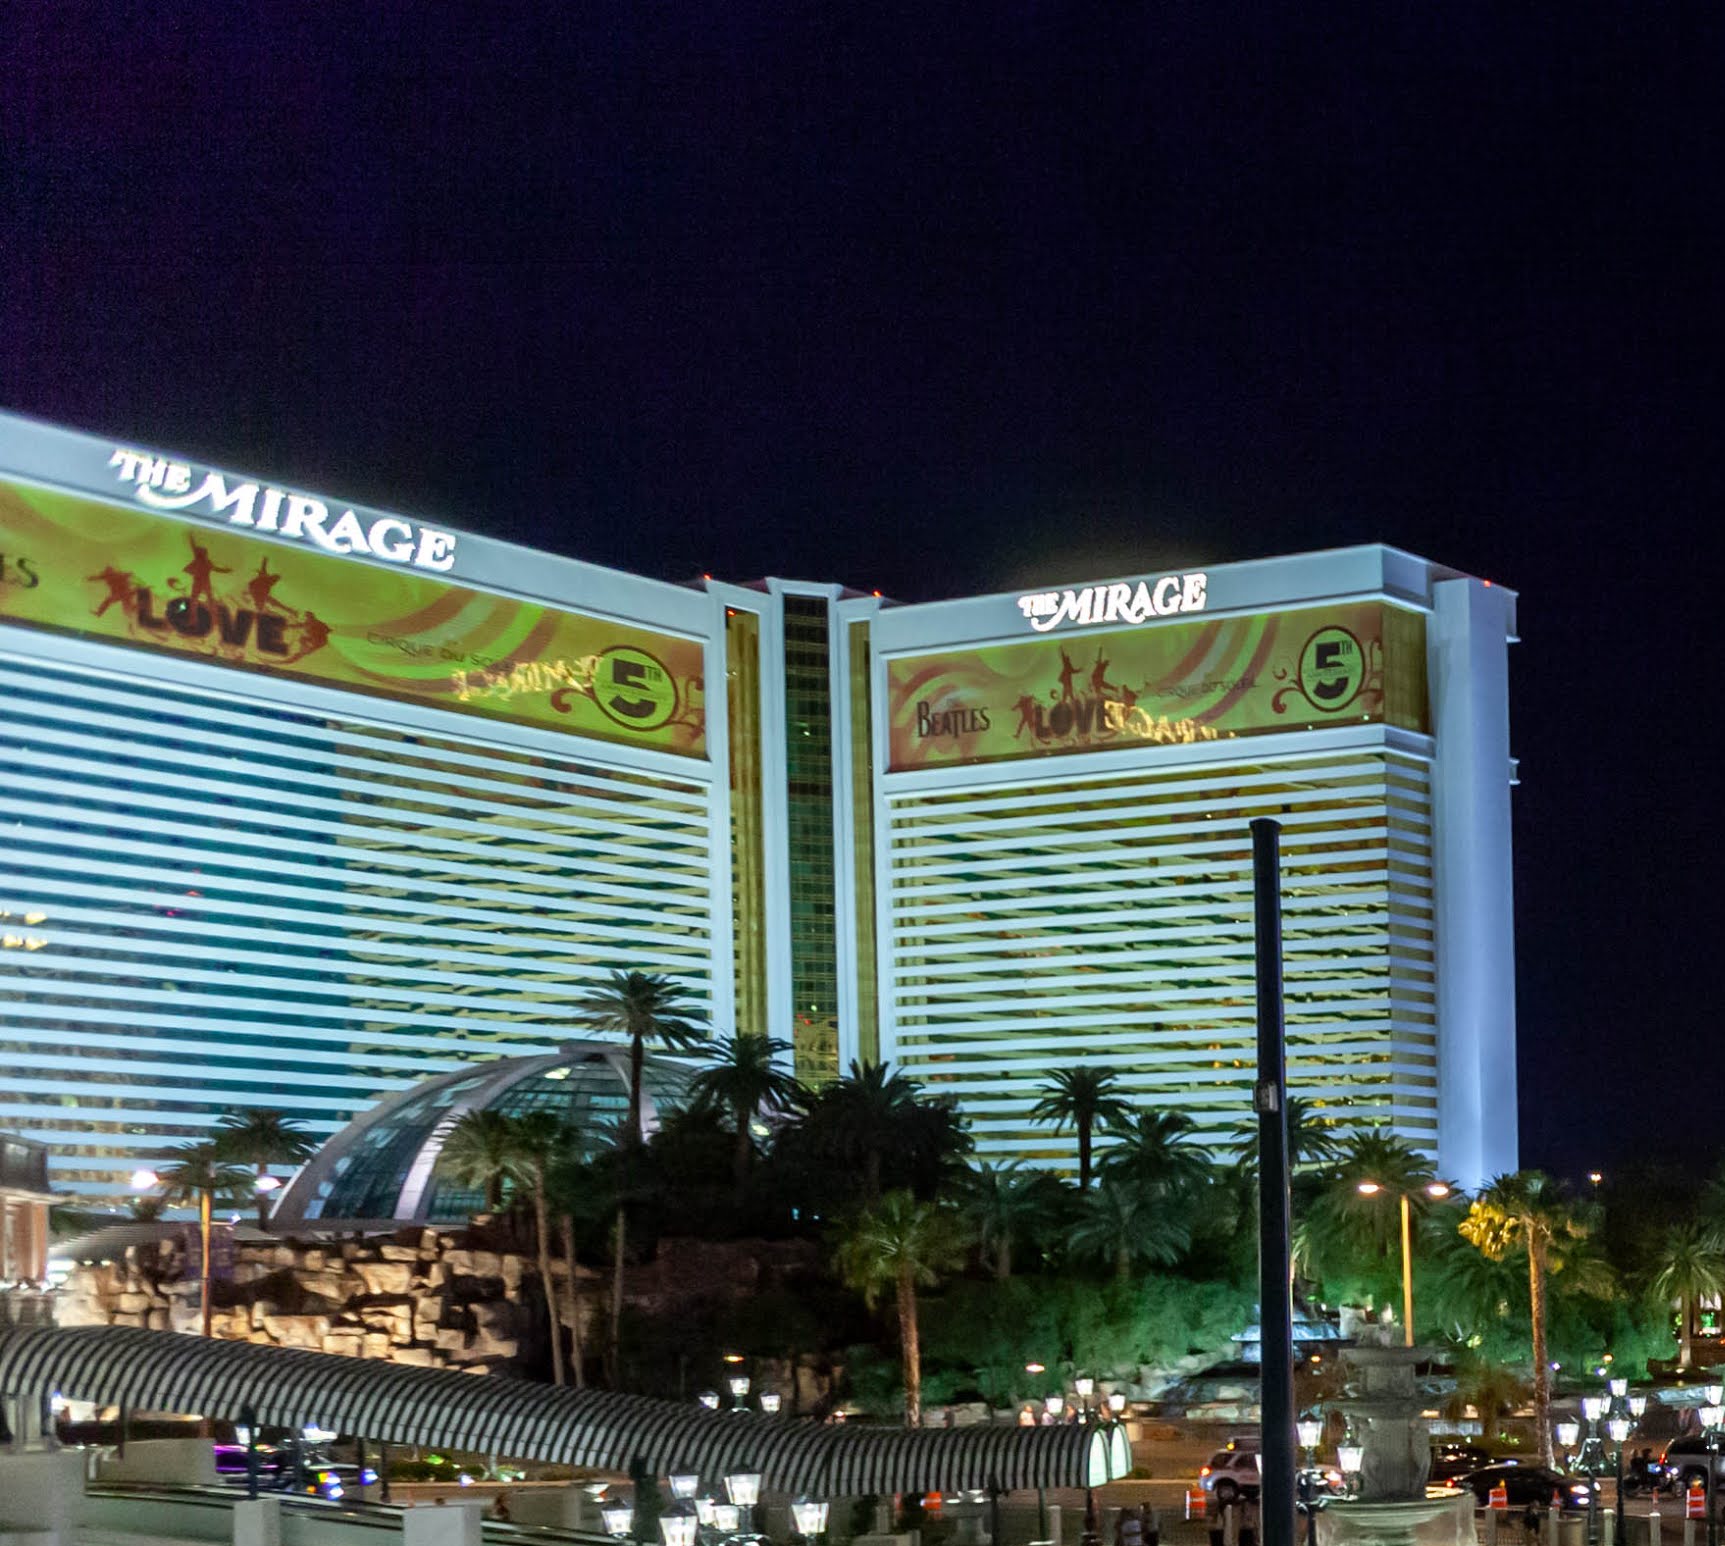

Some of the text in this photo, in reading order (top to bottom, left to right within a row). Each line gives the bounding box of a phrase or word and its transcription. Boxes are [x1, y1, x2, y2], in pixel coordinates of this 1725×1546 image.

[110, 449, 456, 572] THE MIRAGE
[136, 587, 289, 656] LOVE
[1018, 573, 1207, 632] THE MIRAGE
[917, 700, 991, 738] BEATLES
